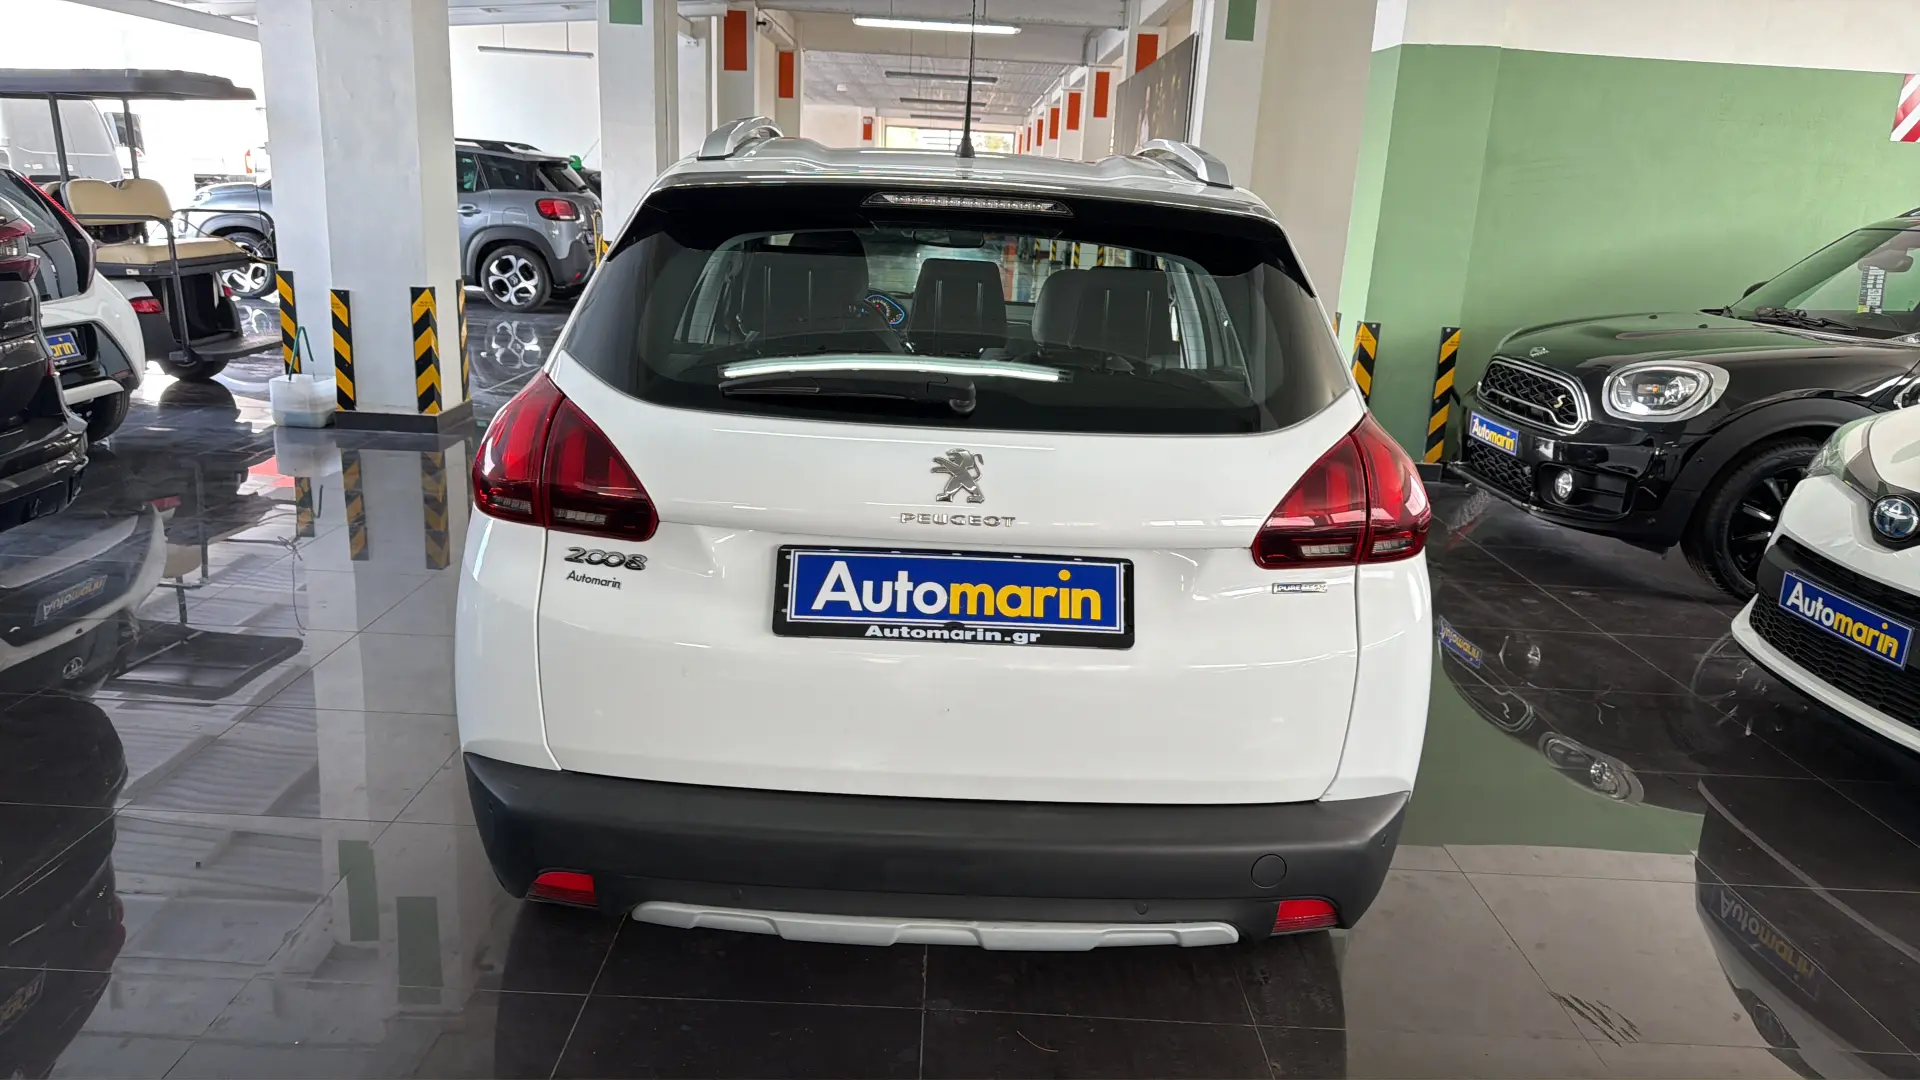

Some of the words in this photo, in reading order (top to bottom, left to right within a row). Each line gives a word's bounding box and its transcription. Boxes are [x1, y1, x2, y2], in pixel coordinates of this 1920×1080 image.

[1471, 417, 1515, 451] Automarin
[900, 512, 1016, 528] PEUGEOT
[564, 546, 648, 571] 2008
[566, 570, 621, 590] Automarin
[810, 560, 1101, 621] Automarin
[1786, 581, 1899, 659] Automarin
[864, 624, 1041, 645] Automarin.gr
